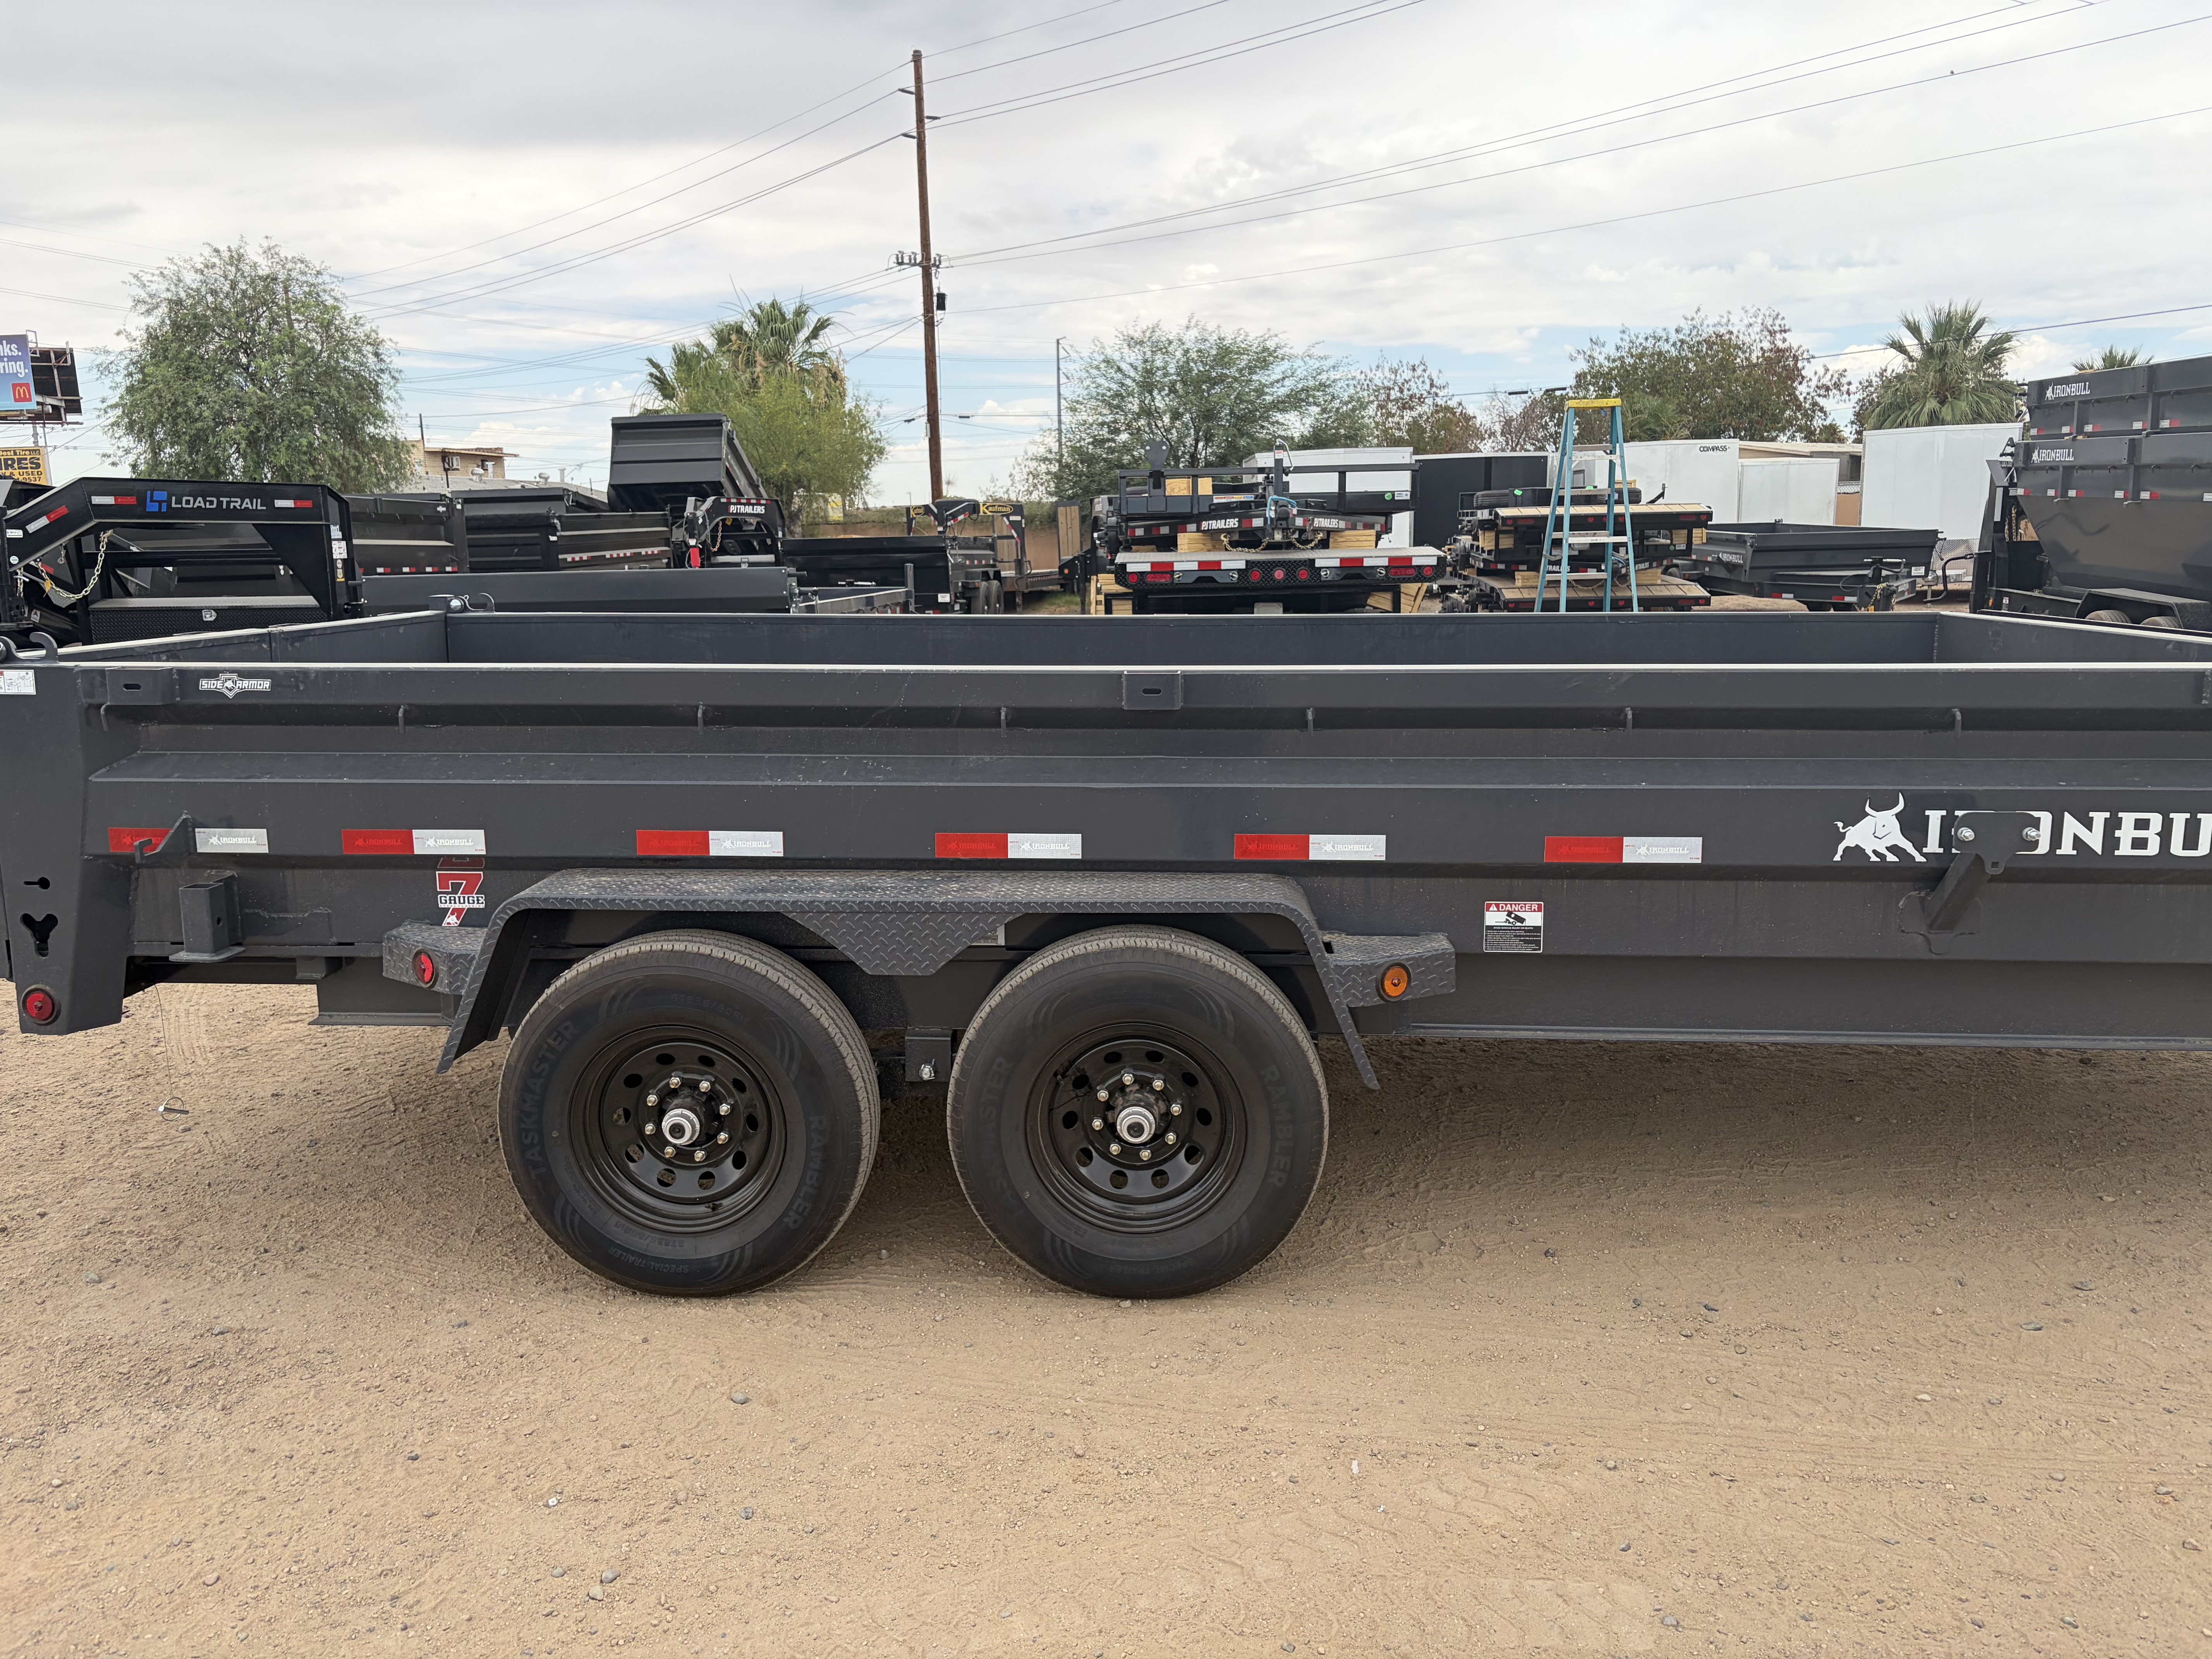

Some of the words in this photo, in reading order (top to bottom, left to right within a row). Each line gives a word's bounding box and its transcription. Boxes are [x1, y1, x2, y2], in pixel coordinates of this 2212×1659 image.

[2054, 382, 2090, 397] IRONBULL
[2039, 449, 2074, 461] IRONBULL
[171, 496, 217, 508] LOAD
[220, 498, 266, 510] TRAIL
[1722, 553, 1743, 563] IRONBULL
[201, 680, 223, 689] SIDE
[236, 681, 270, 689] ARMOR
[1922, 810, 2212, 857] INBU
[438, 895, 485, 905] GAUGE
[520, 1020, 580, 1181] TASKMASTER
[1259, 1064, 1294, 1188] RAMBLER
[781, 1115, 829, 1230] RAMBLER
[607, 1245, 646, 1268] TRAILER
[650, 1261, 689, 1274] SPECIAL
